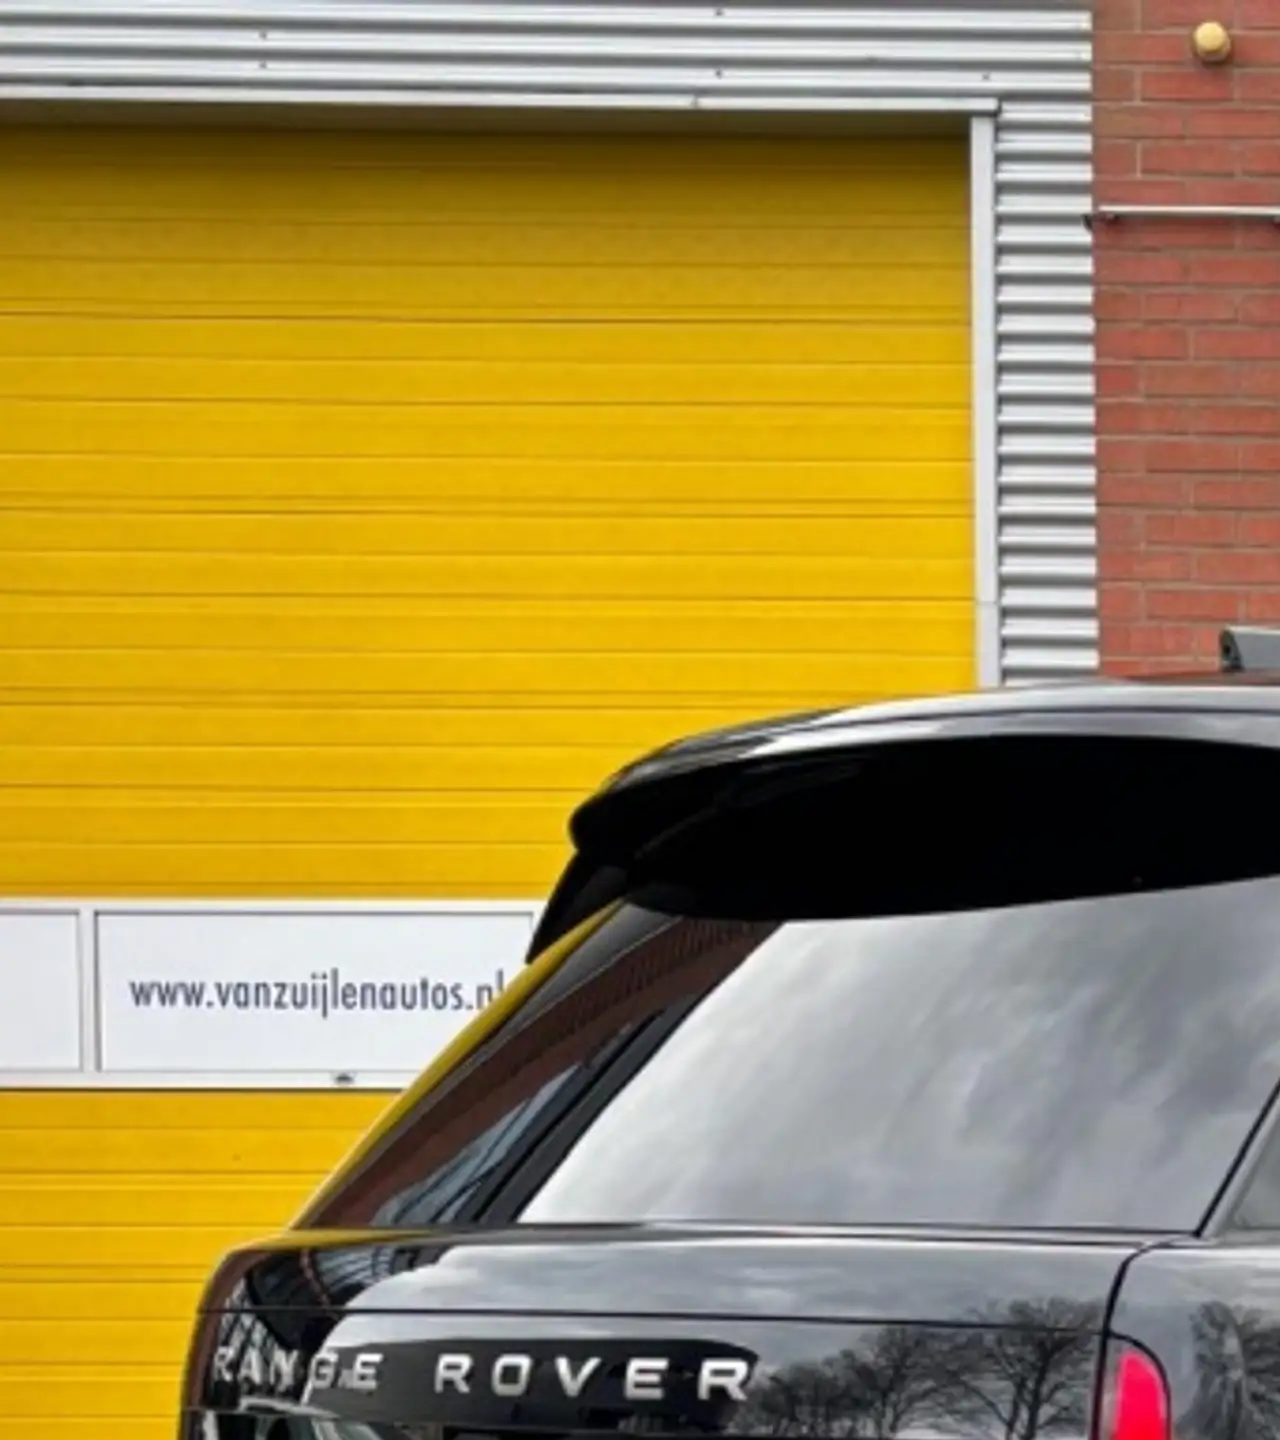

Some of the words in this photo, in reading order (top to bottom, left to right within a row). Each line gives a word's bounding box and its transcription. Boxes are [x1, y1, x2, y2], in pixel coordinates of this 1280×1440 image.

[129, 968, 505, 1018] www.vanzuijlenautos.nl
[213, 1347, 383, 1389] RANGE
[434, 1353, 749, 1400] ROVER
